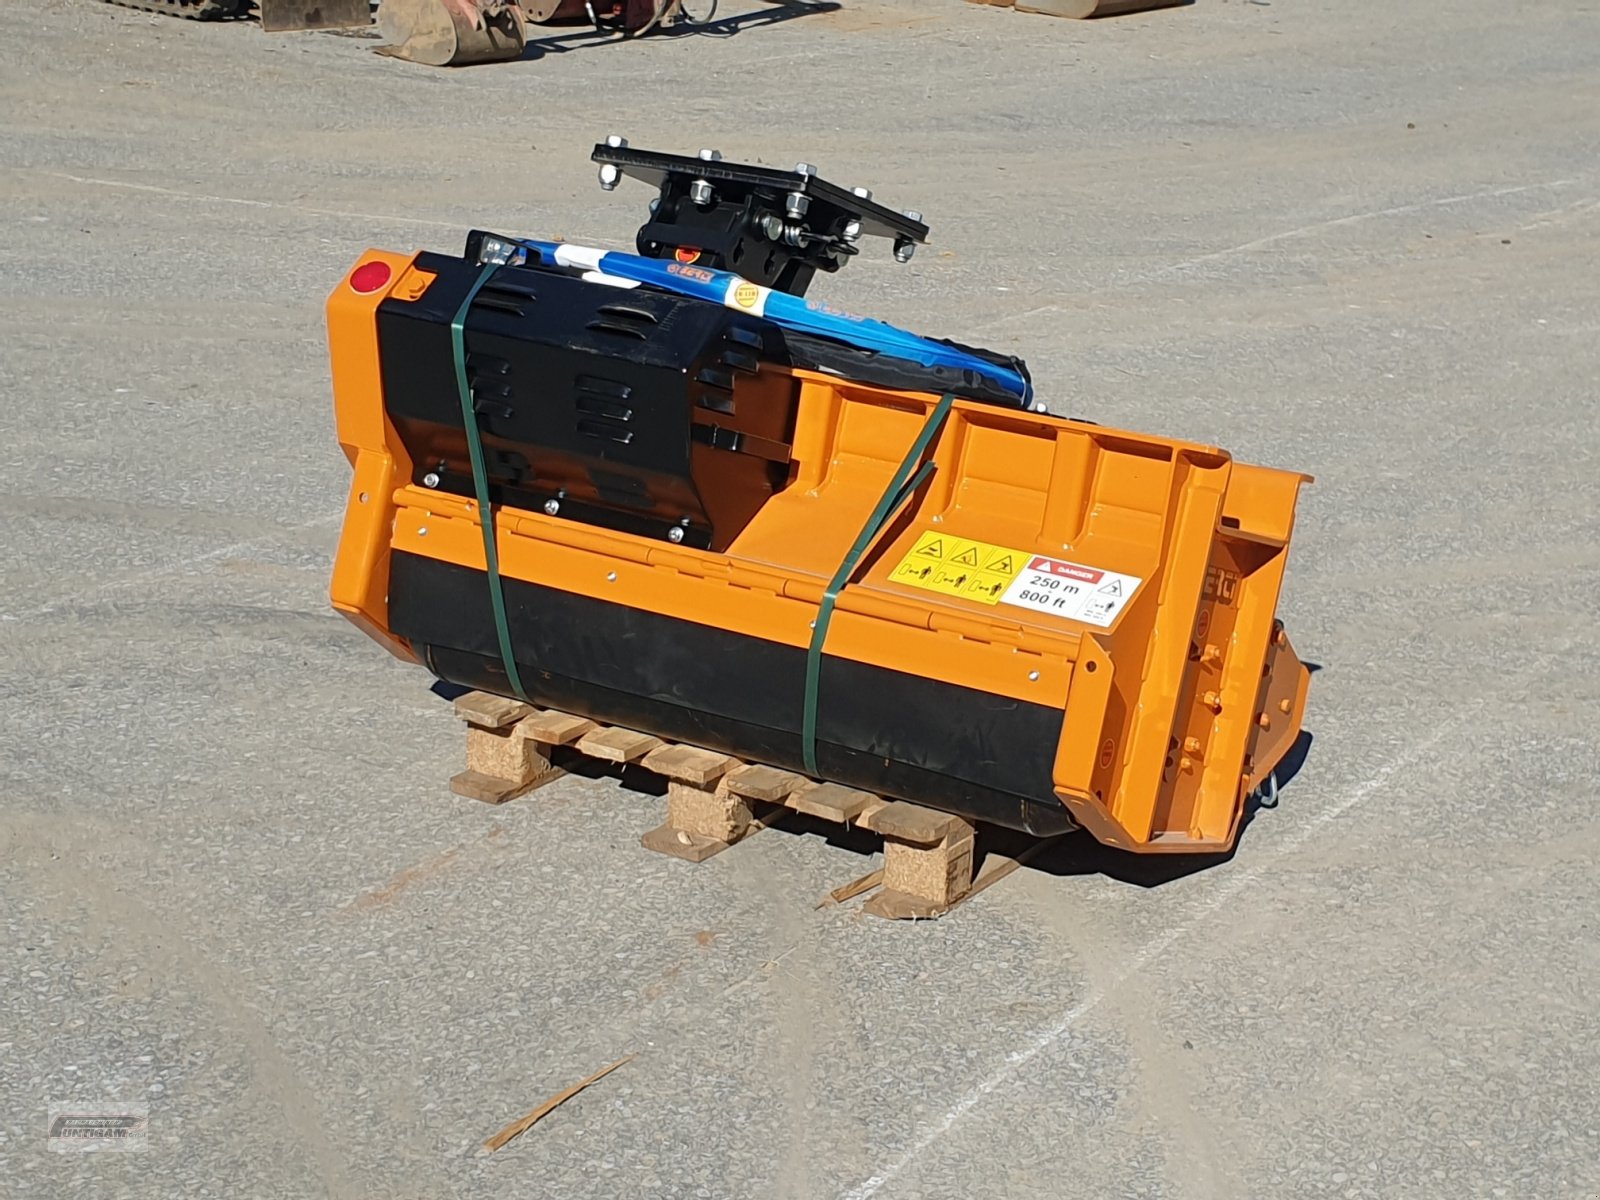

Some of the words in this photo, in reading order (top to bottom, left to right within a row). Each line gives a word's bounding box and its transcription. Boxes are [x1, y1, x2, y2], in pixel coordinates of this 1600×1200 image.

[1057, 566, 1095, 580] DANGER
[1029, 575, 1061, 590] 250
[1063, 585, 1080, 595] m
[1019, 590, 1050, 604] 800
[1053, 598, 1066, 608] ft
